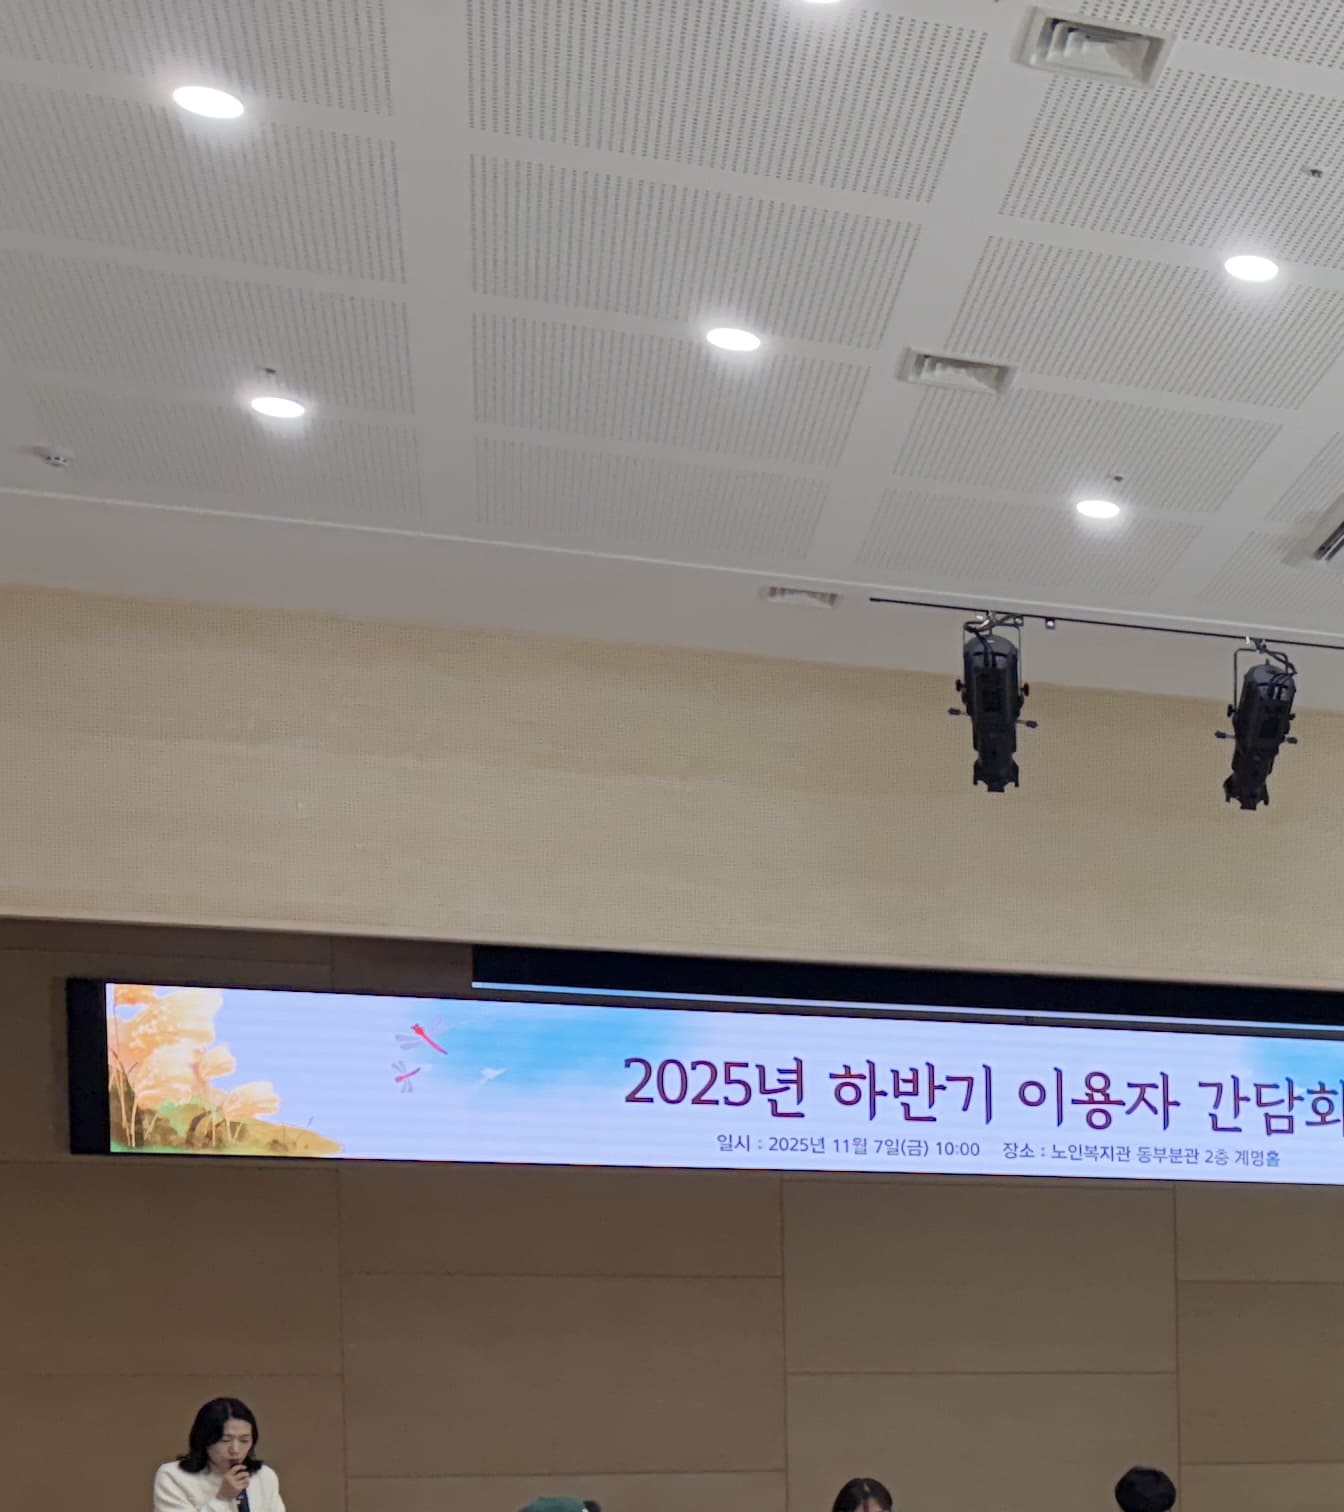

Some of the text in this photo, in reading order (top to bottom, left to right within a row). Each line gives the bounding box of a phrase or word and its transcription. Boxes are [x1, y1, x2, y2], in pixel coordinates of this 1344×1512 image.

[624, 1057, 805, 1118] 2025년
[828, 1059, 992, 1125] 하반기
[1018, 1067, 1181, 1131] 이용자
[717, 1134, 750, 1152] 일시
[768, 1137, 825, 1154] 2025년
[833, 1137, 868, 1155] 11월
[873, 1138, 929, 1157] 7일(금)
[936, 1142, 980, 1156] 10:00
[1002, 1142, 1035, 1159] 장소
[1051, 1144, 1132, 1162] 노인복지관
[1136, 1146, 1200, 1165] 동부분관
